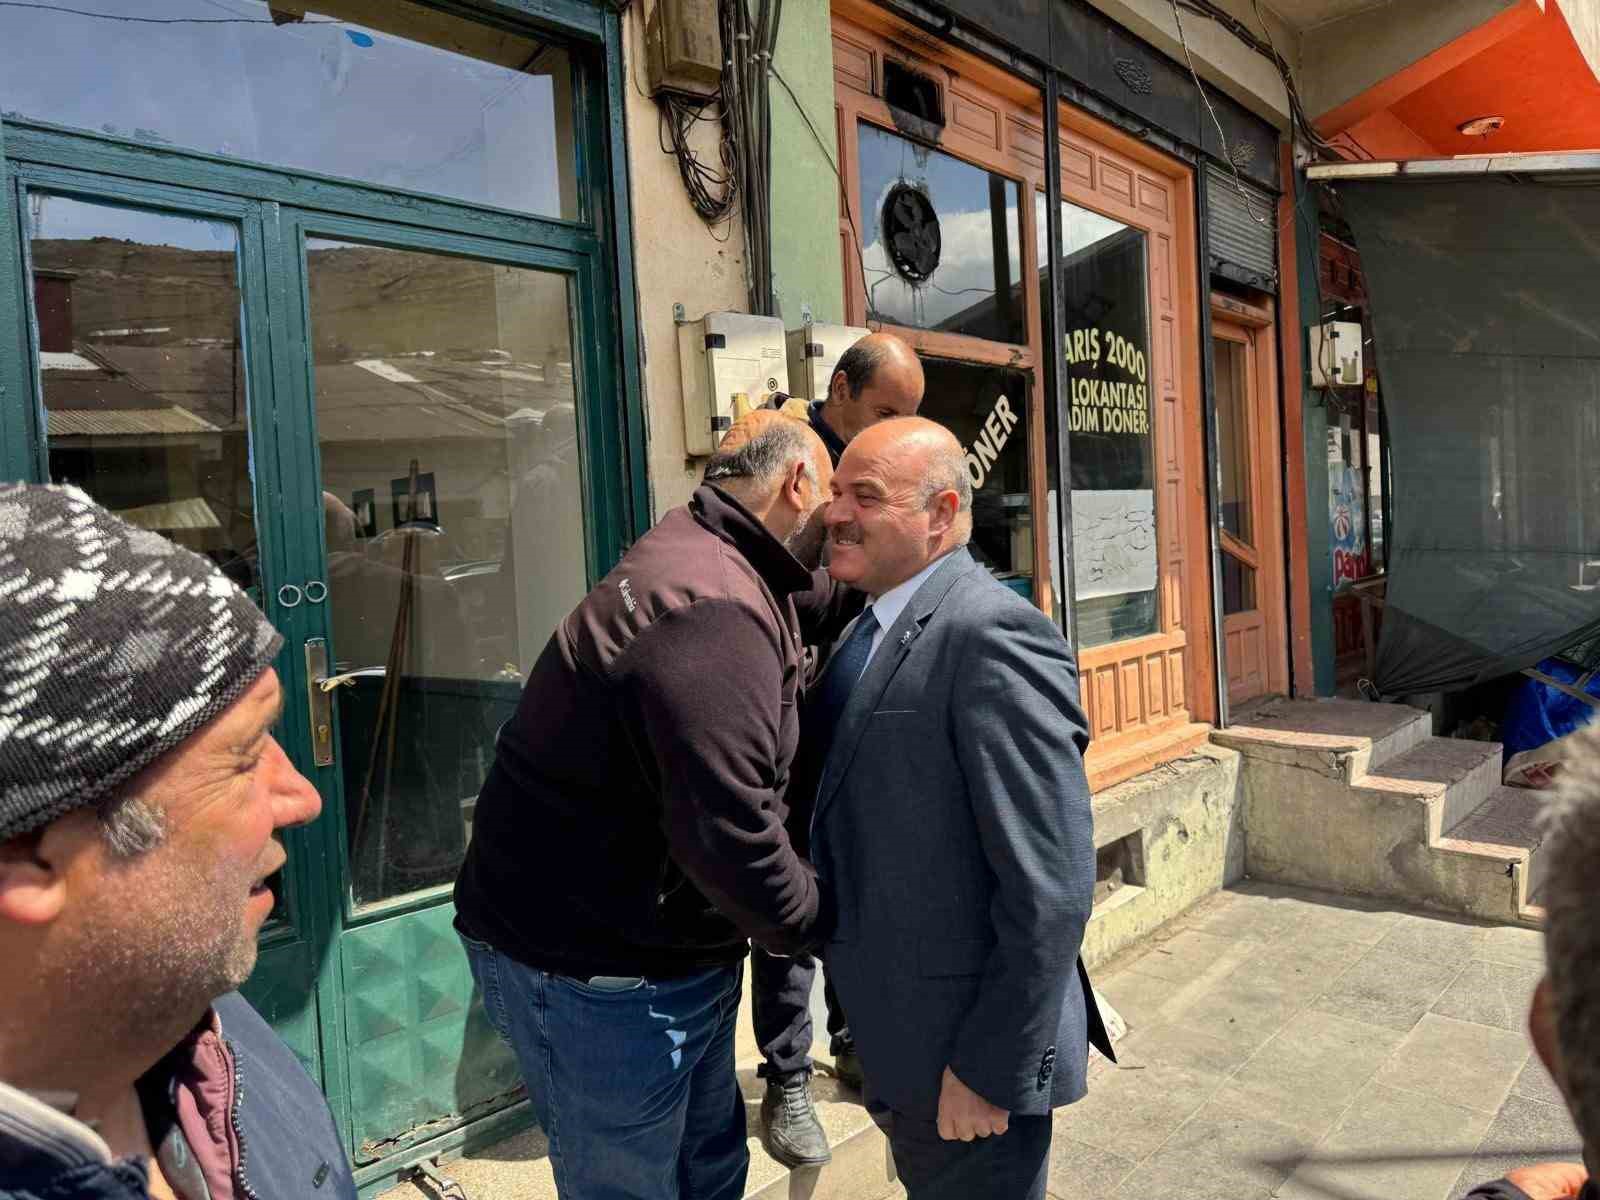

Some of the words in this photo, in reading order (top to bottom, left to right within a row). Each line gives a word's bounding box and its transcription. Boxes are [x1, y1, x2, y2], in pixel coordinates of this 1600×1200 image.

[1064, 327, 1101, 369] ARIŞ
[1105, 330, 1146, 384] 2000
[1071, 377, 1148, 410] LOKANTASI
[961, 394, 1018, 489] ÖNER
